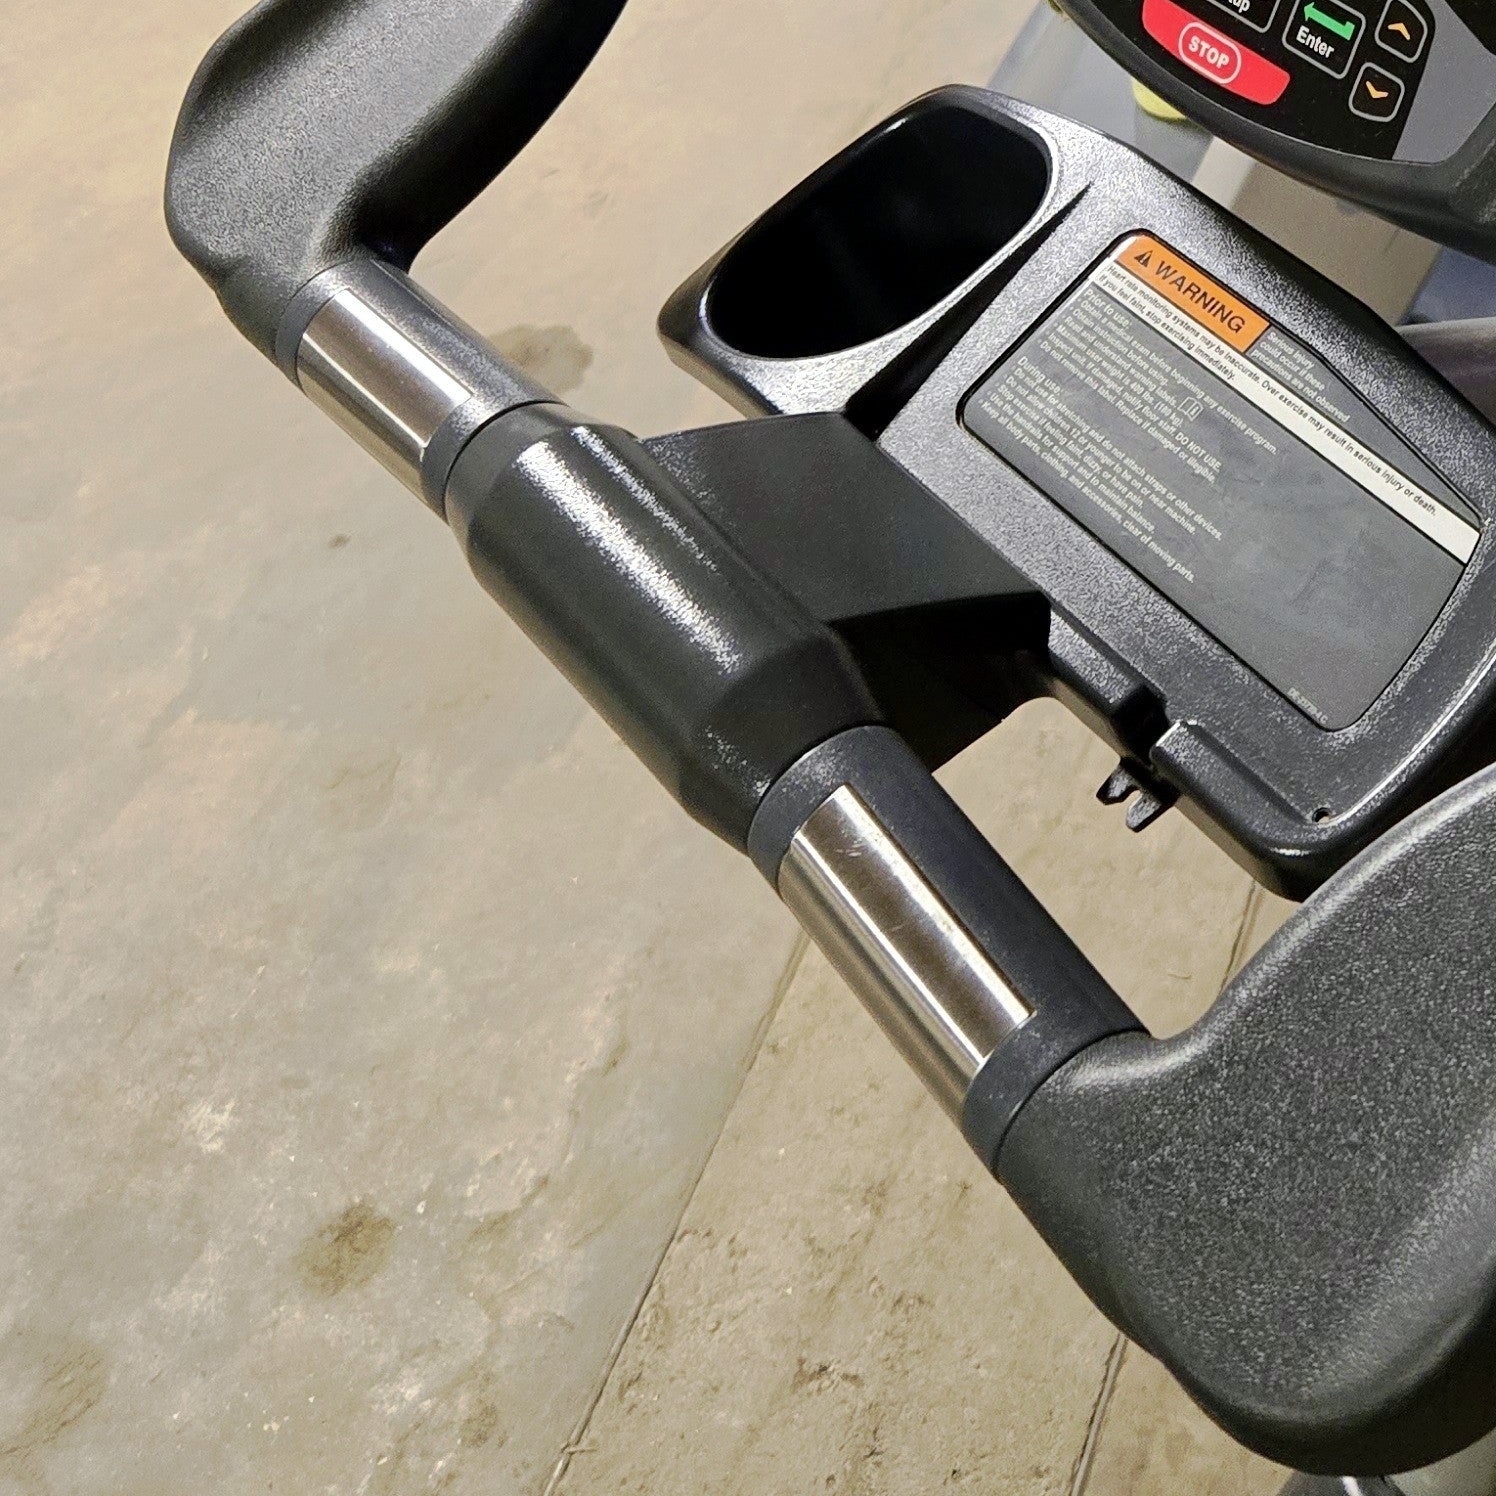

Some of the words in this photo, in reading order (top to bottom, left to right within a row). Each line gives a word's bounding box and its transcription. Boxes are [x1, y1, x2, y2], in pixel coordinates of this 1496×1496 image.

[1187, 35, 1231, 69] STOP
[1296, 25, 1335, 59] Enter
[1082, 288, 1107, 309] Prior
[1111, 311, 1133, 329] use:
[1150, 259, 1248, 334] WARNING
[1097, 273, 1107, 282] If
[1102, 279, 1118, 293] you
[1116, 287, 1132, 301] feel
[1143, 308, 1164, 326] stop
[1158, 319, 1196, 351] exercising
[1192, 344, 1238, 382] immediately.
[1265, 330, 1296, 356] Serious
[1290, 349, 1316, 371] injury
[1015, 355, 1048, 384] During
[1042, 377, 1064, 396] use:
[1249, 347, 1294, 383] precautions
[1289, 376, 1305, 390] are
[1301, 384, 1318, 399] not
[1314, 393, 1351, 423] observed
[1258, 338, 1282, 359] could
[1277, 354, 1300, 373] occur
[1303, 371, 1327, 392] these
[1105, 264, 1127, 283] Heart
[1123, 277, 1140, 292] rate
[1134, 287, 1174, 319] monitoring
[1169, 313, 1202, 340] systems
[1196, 334, 1215, 351] may
[1213, 344, 1226, 357] be
[1222, 351, 1263, 384] inaccurate.
[1259, 379, 1280, 397] Over
[1277, 392, 1310, 419] exercise
[1305, 415, 1325, 433] may
[1322, 426, 1347, 447] result
[1344, 441, 1356, 454] in
[1352, 448, 1383, 474] serious
[1379, 468, 1406, 493] injury
[1402, 487, 1414, 498] or
[1412, 492, 1440, 516] death.
